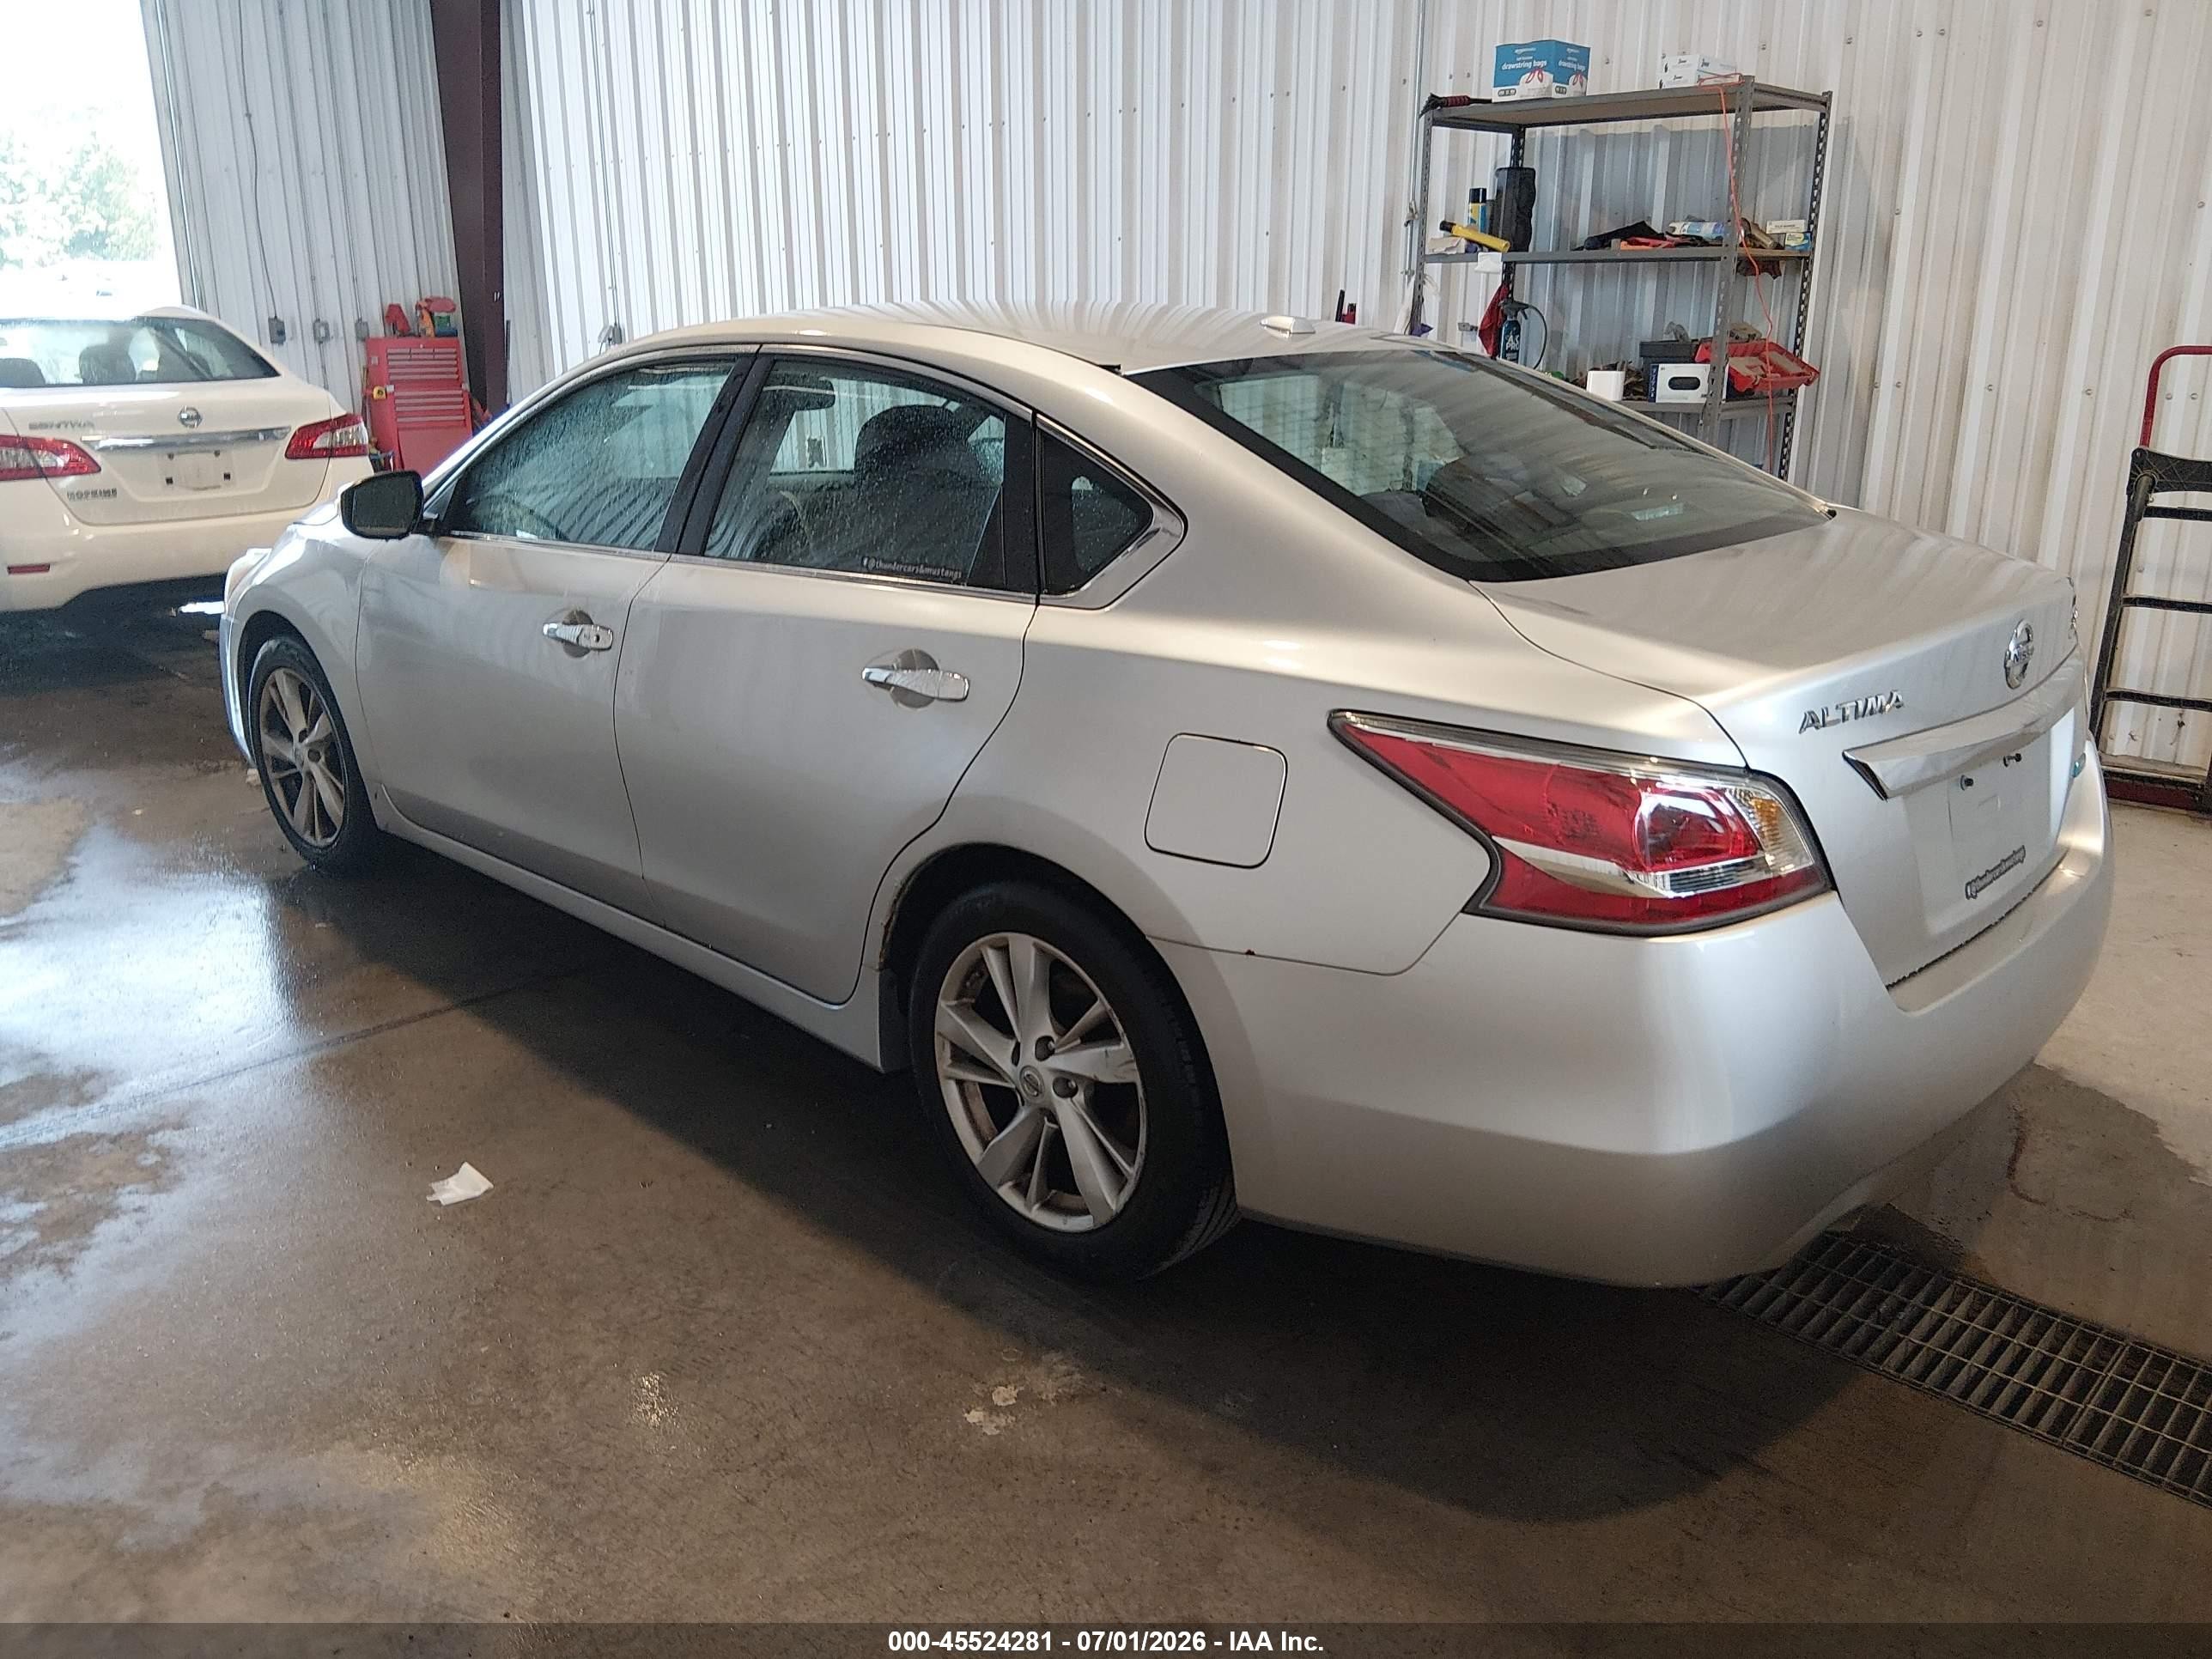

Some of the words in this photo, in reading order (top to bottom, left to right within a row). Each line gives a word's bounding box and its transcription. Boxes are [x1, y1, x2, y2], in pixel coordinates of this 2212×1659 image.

[1501, 60, 1532, 70] drawstring
[1505, 342, 1520, 350] PRO
[1798, 690, 1904, 734] ALTIMA
